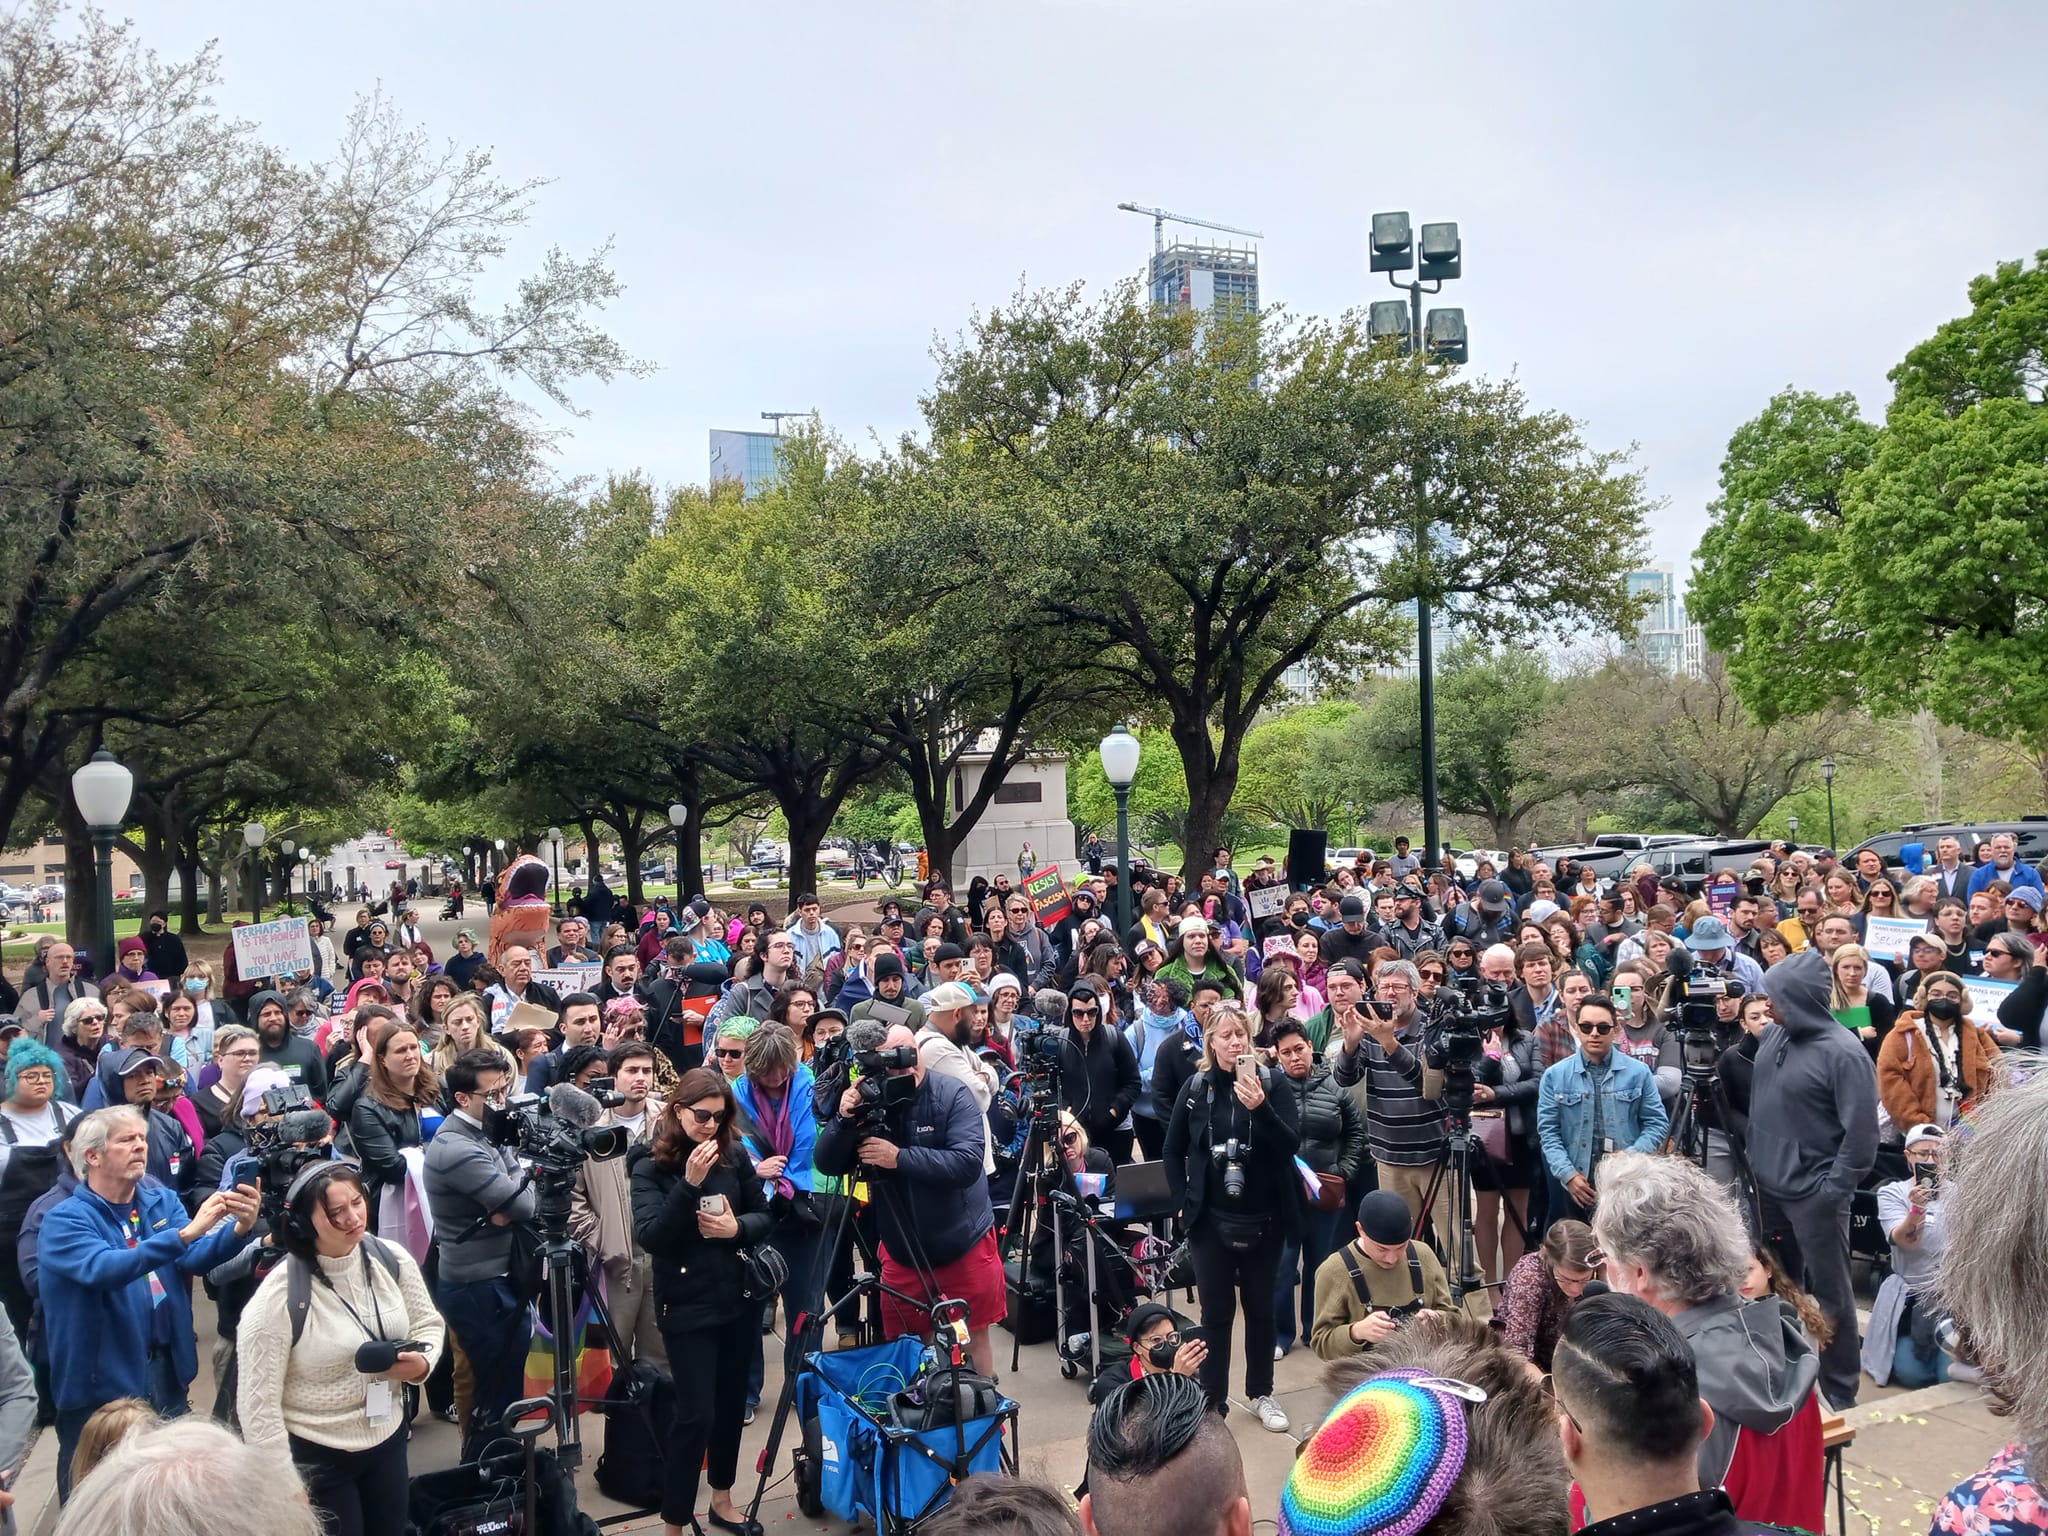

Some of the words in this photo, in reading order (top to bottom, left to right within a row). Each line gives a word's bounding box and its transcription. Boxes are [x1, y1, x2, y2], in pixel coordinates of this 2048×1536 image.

[1027, 872, 1059, 896] RESIST
[1033, 889, 1067, 911] FASCISM
[236, 922, 282, 939] PERHAPS
[283, 919, 306, 931] THIS
[241, 937, 251, 947] IS
[252, 934, 270, 946] THE
[270, 929, 305, 943] MOMENT
[244, 965, 265, 978] BEEN
[269, 957, 310, 975] CREATED
[252, 954, 270, 967] YOU
[273, 950, 297, 963] HAVE
